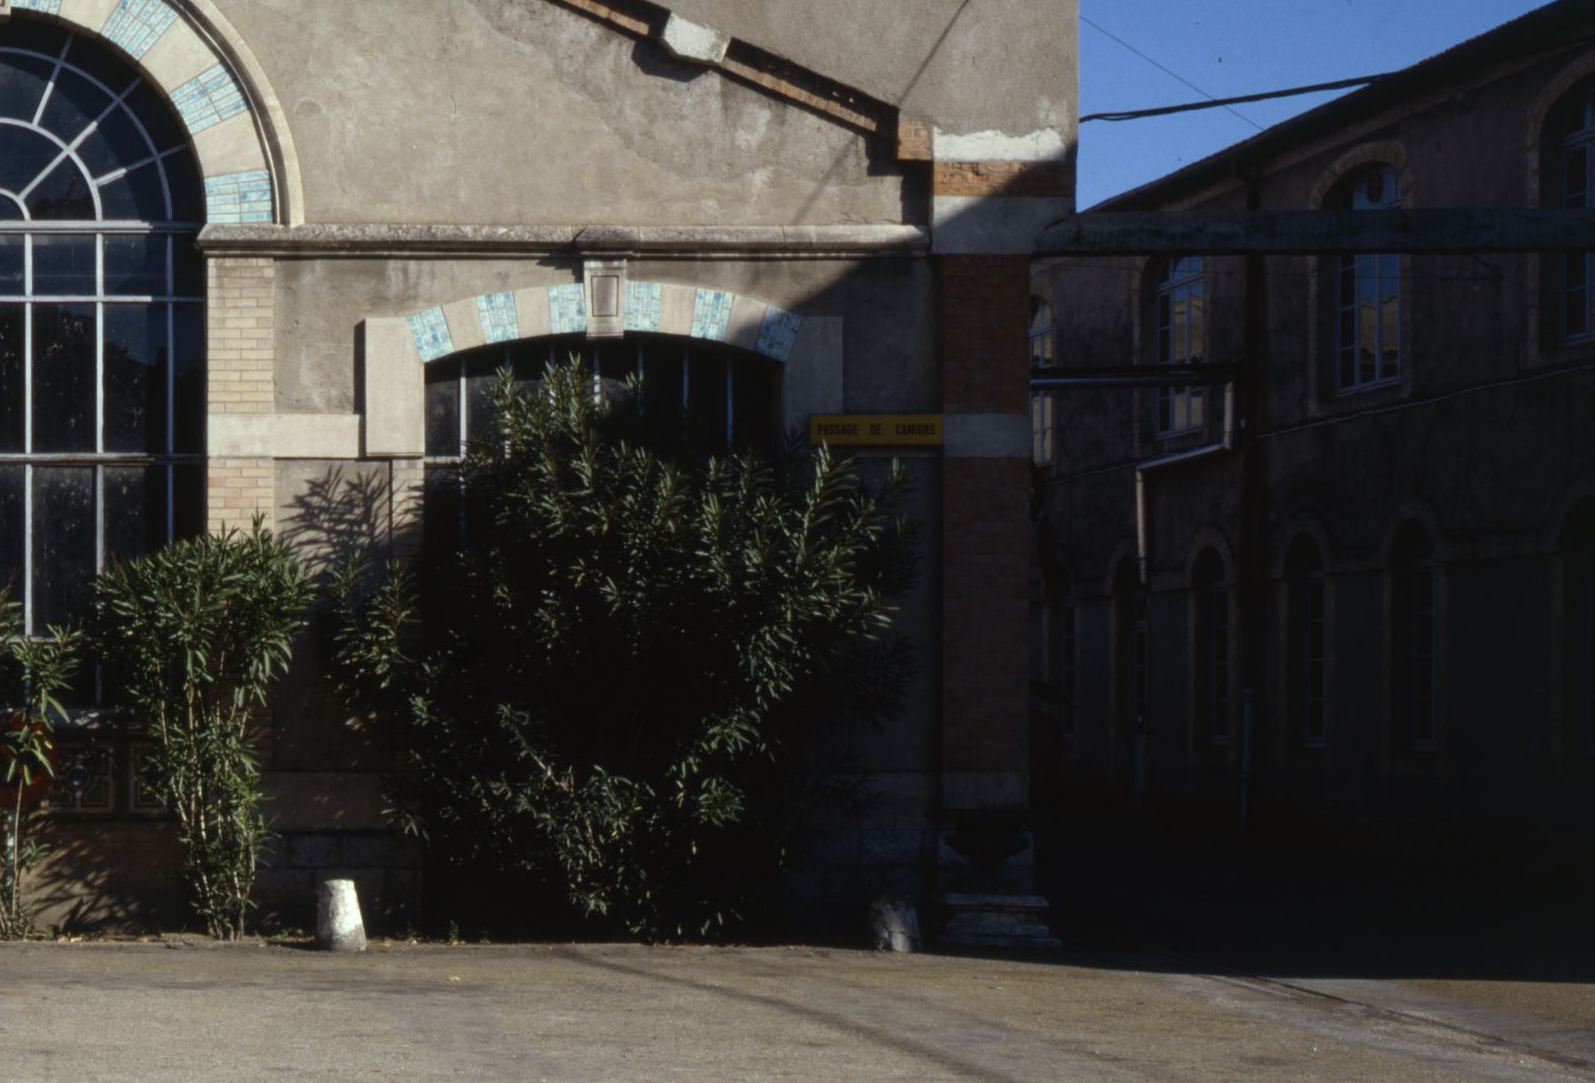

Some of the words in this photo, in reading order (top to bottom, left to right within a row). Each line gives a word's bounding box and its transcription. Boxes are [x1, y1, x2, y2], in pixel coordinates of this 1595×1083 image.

[817, 423, 858, 436] PASSAGE
[869, 423, 883, 436] DE
[895, 423, 936, 436] CAMIONS
